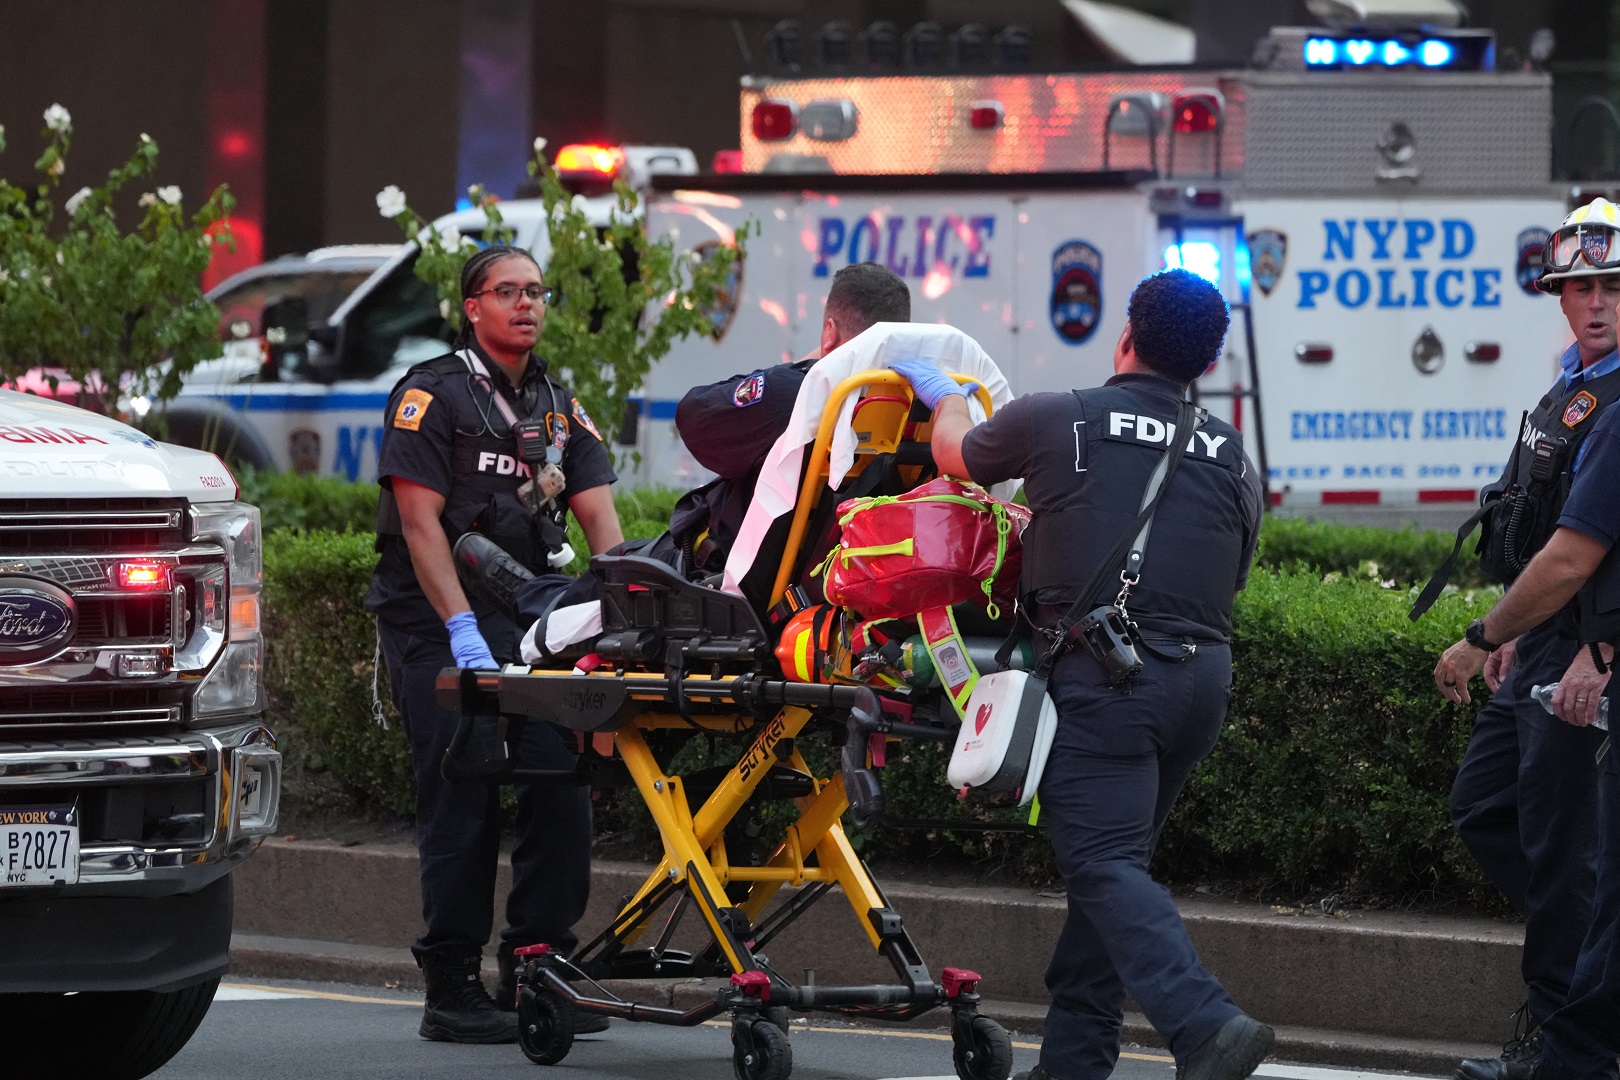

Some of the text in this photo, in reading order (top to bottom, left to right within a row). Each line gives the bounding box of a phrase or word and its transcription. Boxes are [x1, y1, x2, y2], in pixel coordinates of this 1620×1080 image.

[813, 216, 996, 278] POLICE
[1323, 218, 1476, 260] NYPD
[1296, 268, 1502, 309] POLICE
[1291, 409, 1506, 440] EMERGENCY SERVICE
[1522, 414, 1547, 450] DN
[4, 460, 127, 477] DUTY
[478, 451, 533, 479] FDN
[1343, 465, 1404, 477] BACK
[1418, 465, 1461, 477] 200
[18, 811, 48, 823] YORK
[8, 873, 26, 882] NYC
